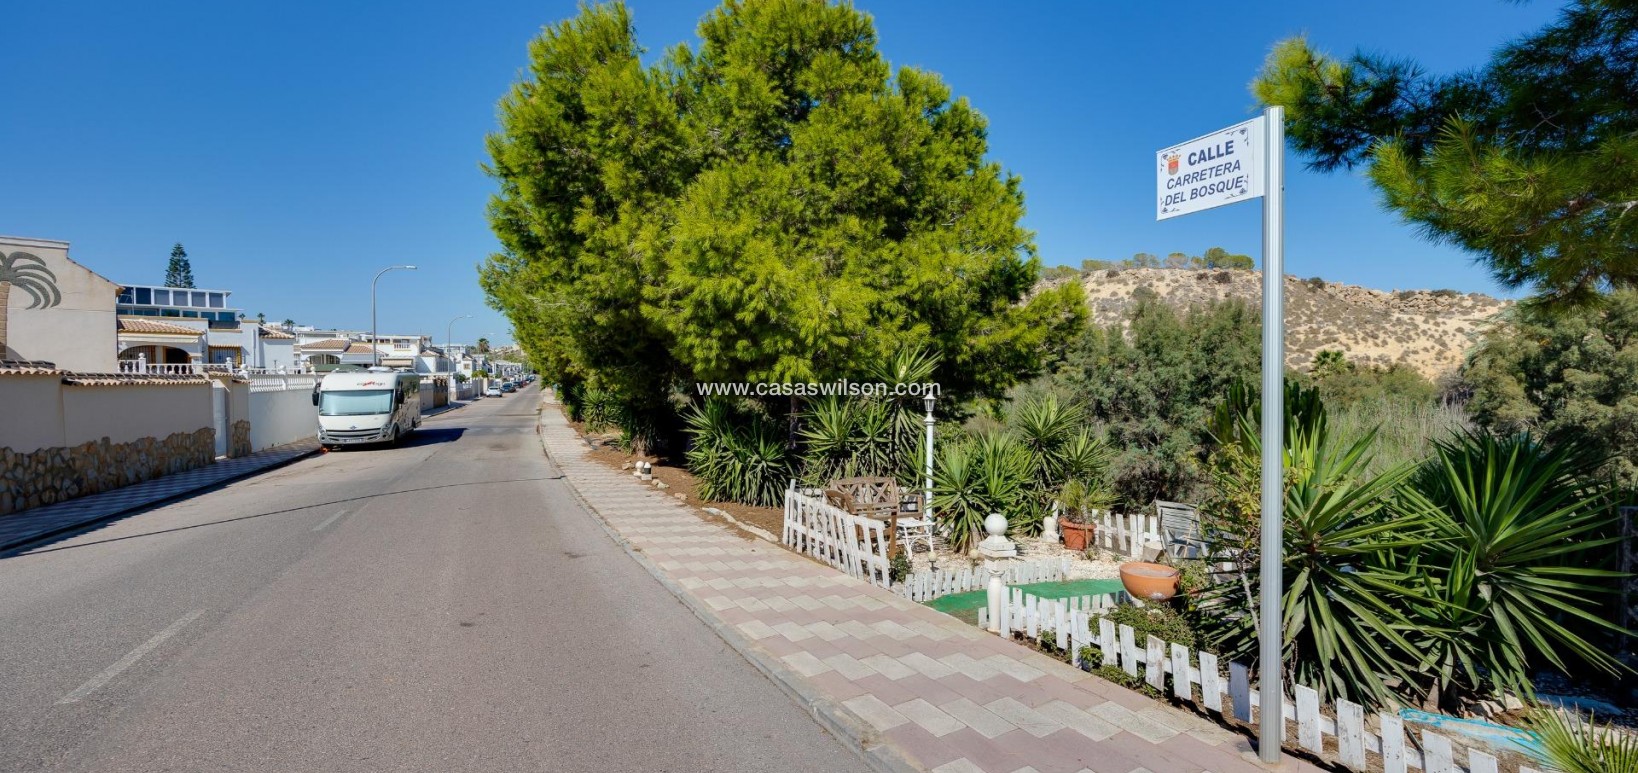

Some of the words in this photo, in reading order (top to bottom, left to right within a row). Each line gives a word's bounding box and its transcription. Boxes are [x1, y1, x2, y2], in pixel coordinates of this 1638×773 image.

[1188, 140, 1234, 166] CALLE
[1167, 160, 1241, 190] CARRETERA
[1165, 191, 1187, 206] DEL
[1190, 176, 1244, 200] BOSQUE
